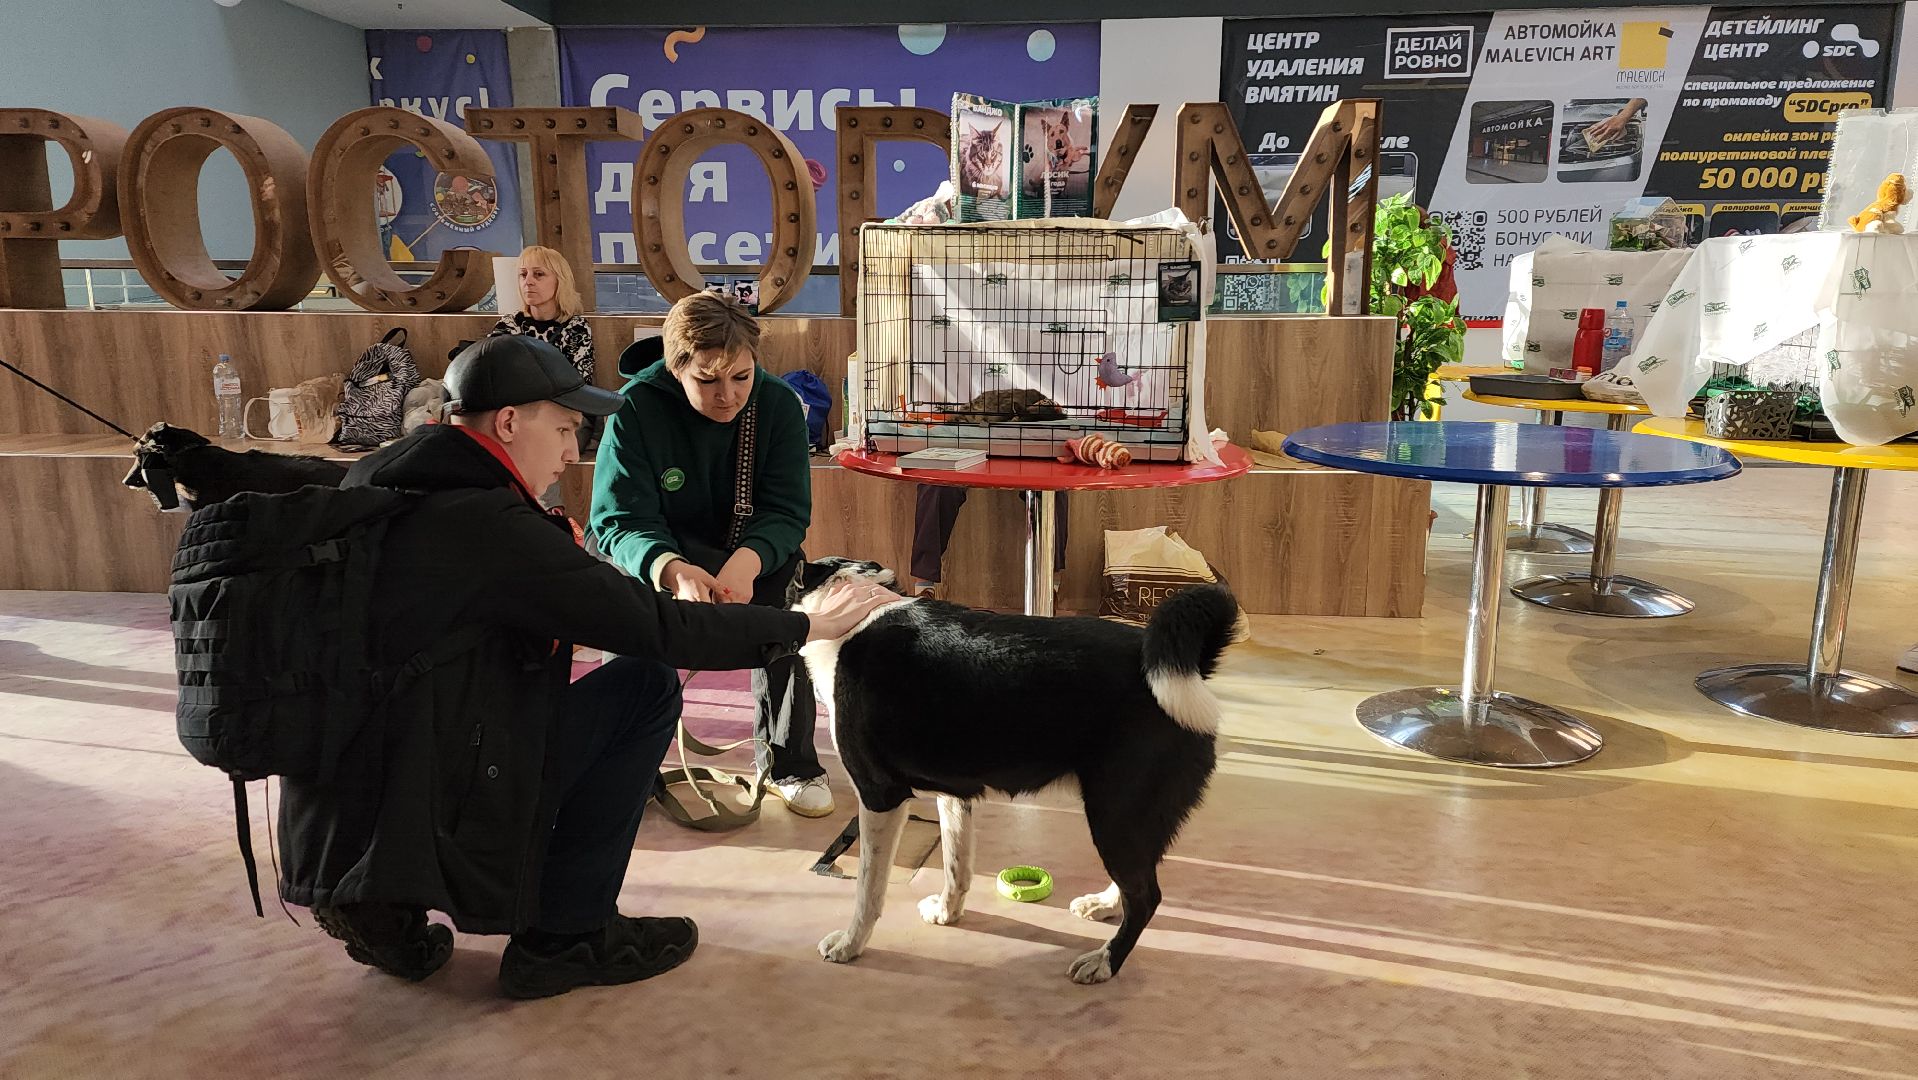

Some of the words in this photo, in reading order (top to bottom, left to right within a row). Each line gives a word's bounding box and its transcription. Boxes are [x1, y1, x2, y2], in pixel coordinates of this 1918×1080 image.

[1504, 20, 1616, 40] АВТОМОЙКА
[1704, 15, 1825, 38] ДЕТЕЙЛИНГ
[1247, 31, 1320, 53] ЦЕНТР
[1395, 33, 1462, 54] ДЕЛАЙ
[1822, 45, 1857, 57] SDC
[1485, 46, 1575, 63] MALEVICH
[1580, 45, 1615, 60] ART
[1703, 42, 1769, 61] ЦЕНТР
[1247, 57, 1364, 80] УДАЛЕНИЯ
[1395, 53, 1462, 69] РОВНО
[1616, 70, 1666, 83] MALEVICH
[1684, 79, 1777, 92] специальное
[1779, 77, 1876, 92] предложение
[1245, 85, 1340, 103] ВМЯТИН
[1683, 97, 1700, 107] по
[1702, 94, 1783, 109] промокоду
[973, 104, 1003, 117] БАНДЖО
[1482, 117, 1543, 133] АВТОМОЙКА
[1258, 132, 1290, 152] До
[1723, 129, 1789, 142] оклейка
[1790, 131, 1818, 141] зон
[1660, 147, 1797, 163] полиуретановой
[1699, 166, 1736, 189] 50
[1741, 166, 1798, 188] 000
[594, 161, 728, 215] дя
[1497, 209, 1529, 223] 500
[1534, 204, 1602, 223] РУБЛЕЙ
[1721, 204, 1771, 212] полировка
[1495, 231, 1593, 246] БОНУСМИ
